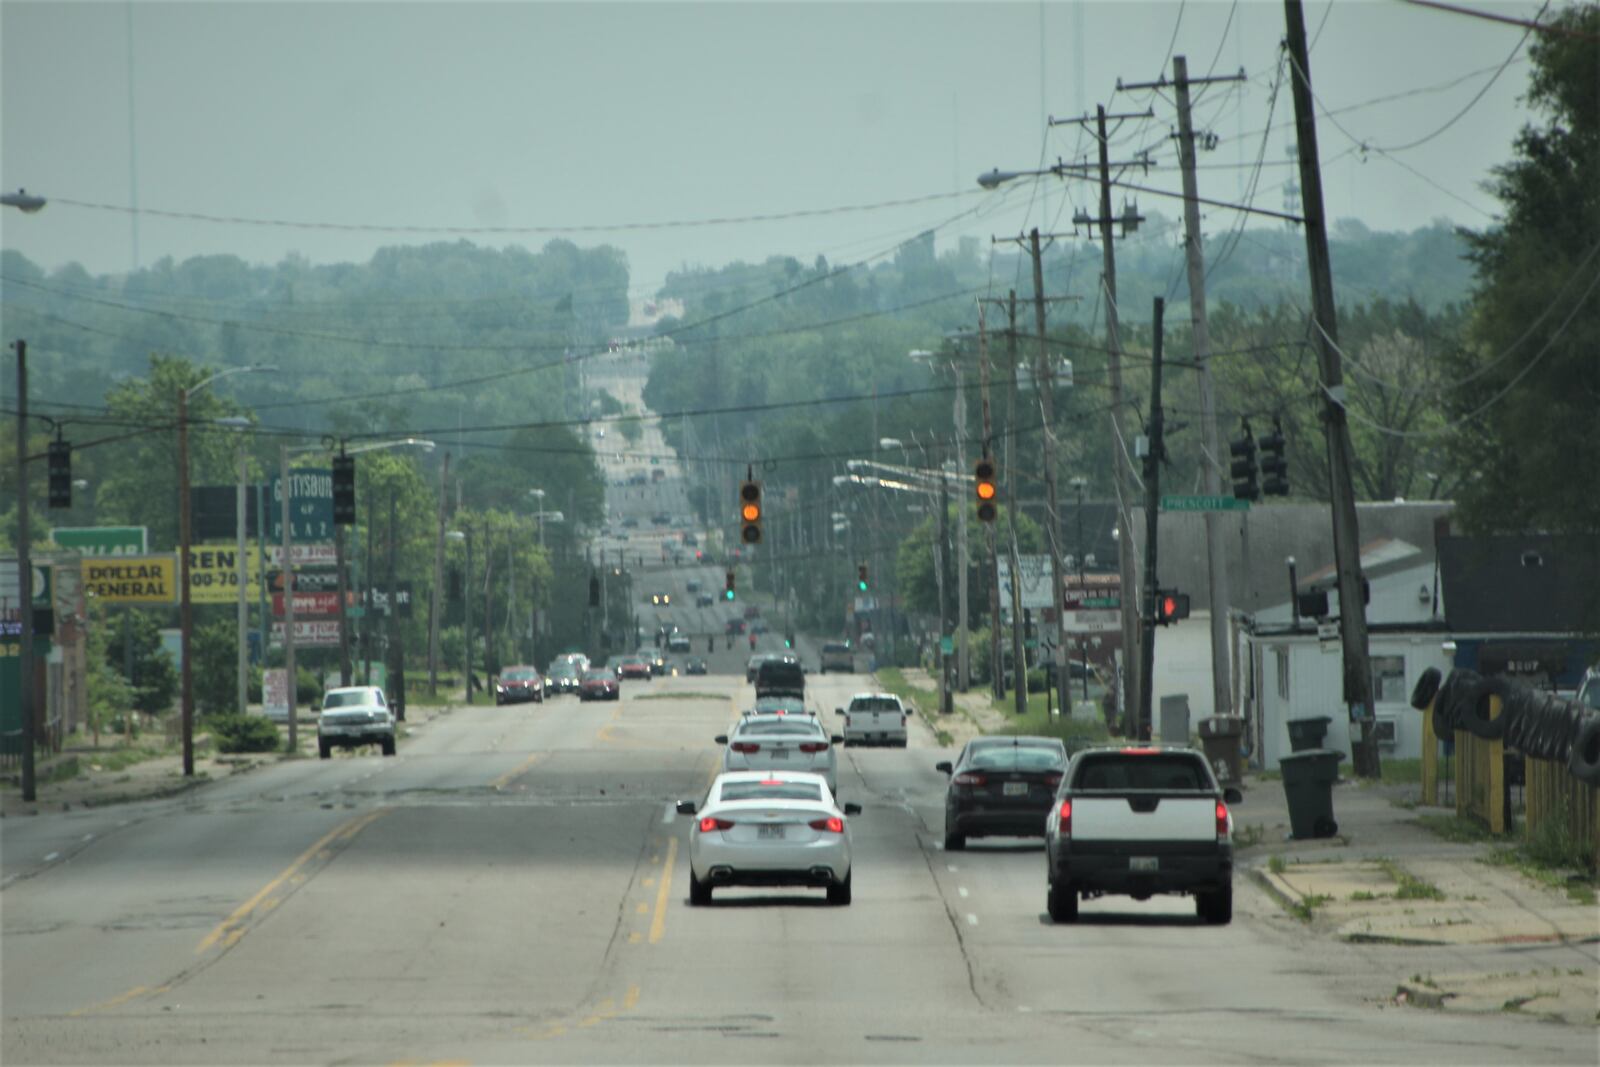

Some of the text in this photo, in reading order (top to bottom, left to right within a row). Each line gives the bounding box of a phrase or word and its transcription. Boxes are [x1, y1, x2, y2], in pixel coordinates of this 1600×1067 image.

[1167, 497, 1223, 510] PRESCOTT
[275, 521, 327, 537] PLAZ
[89, 565, 162, 580] DOLLAR
